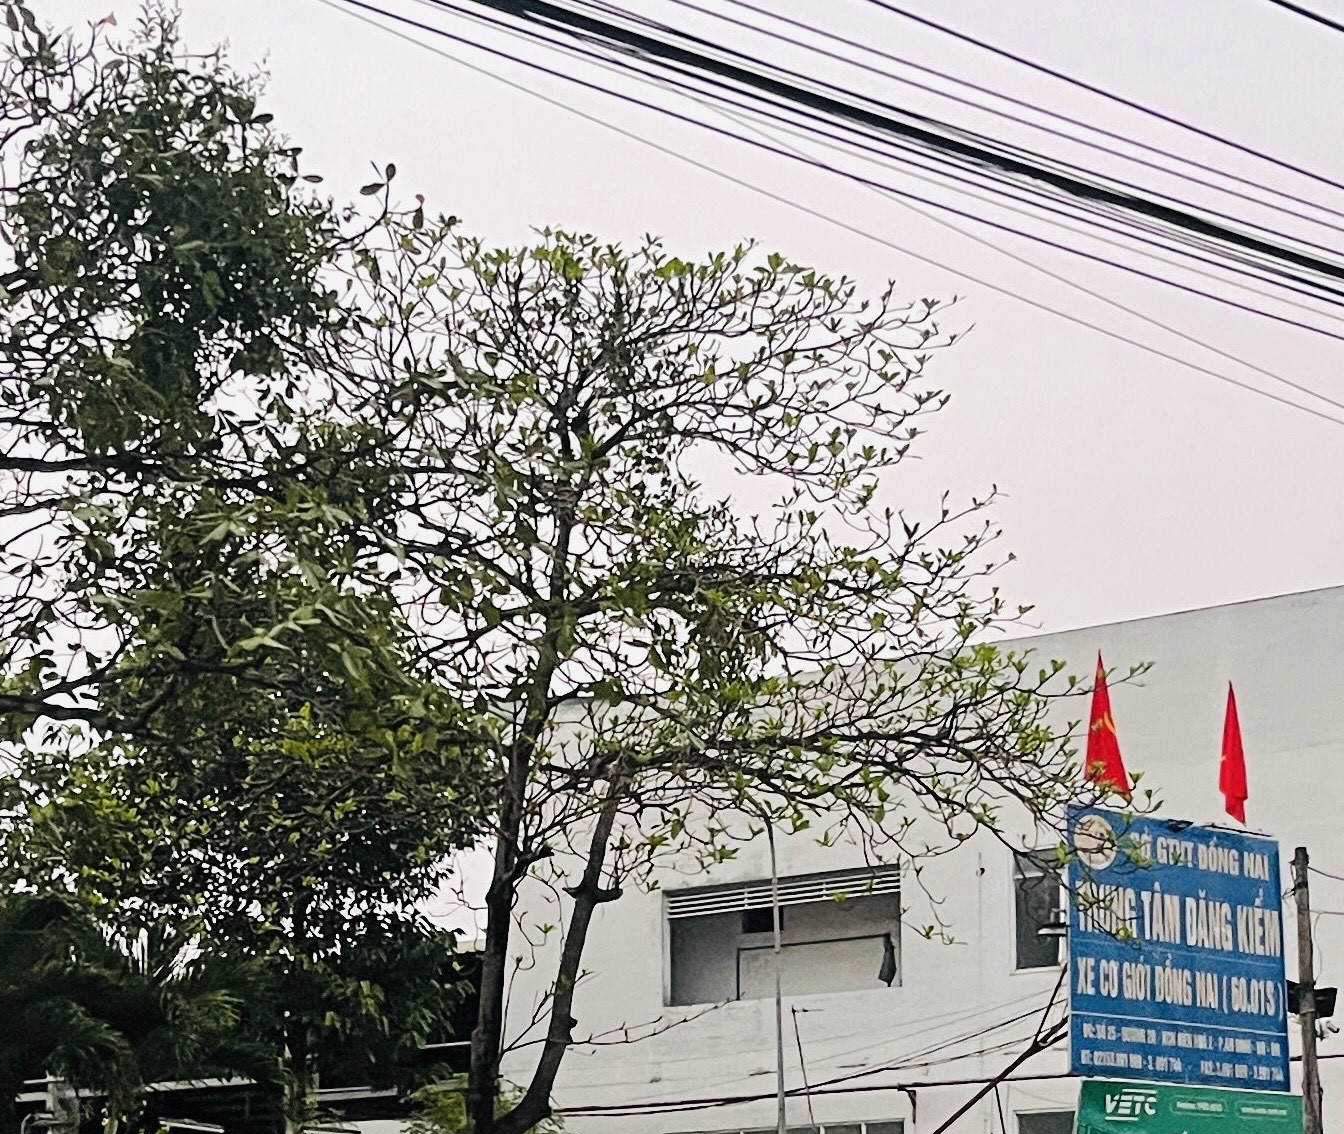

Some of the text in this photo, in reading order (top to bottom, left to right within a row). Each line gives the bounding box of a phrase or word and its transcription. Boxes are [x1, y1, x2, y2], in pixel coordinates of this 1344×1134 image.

[1243, 850, 1271, 883] NAI
[1140, 880, 1182, 945] TÂM
[1185, 888, 1234, 952] ĐĂNG
[1077, 956, 1096, 996] XE
[1195, 969, 1220, 1010] NAI
[1105, 1093, 1157, 1116] VETC
